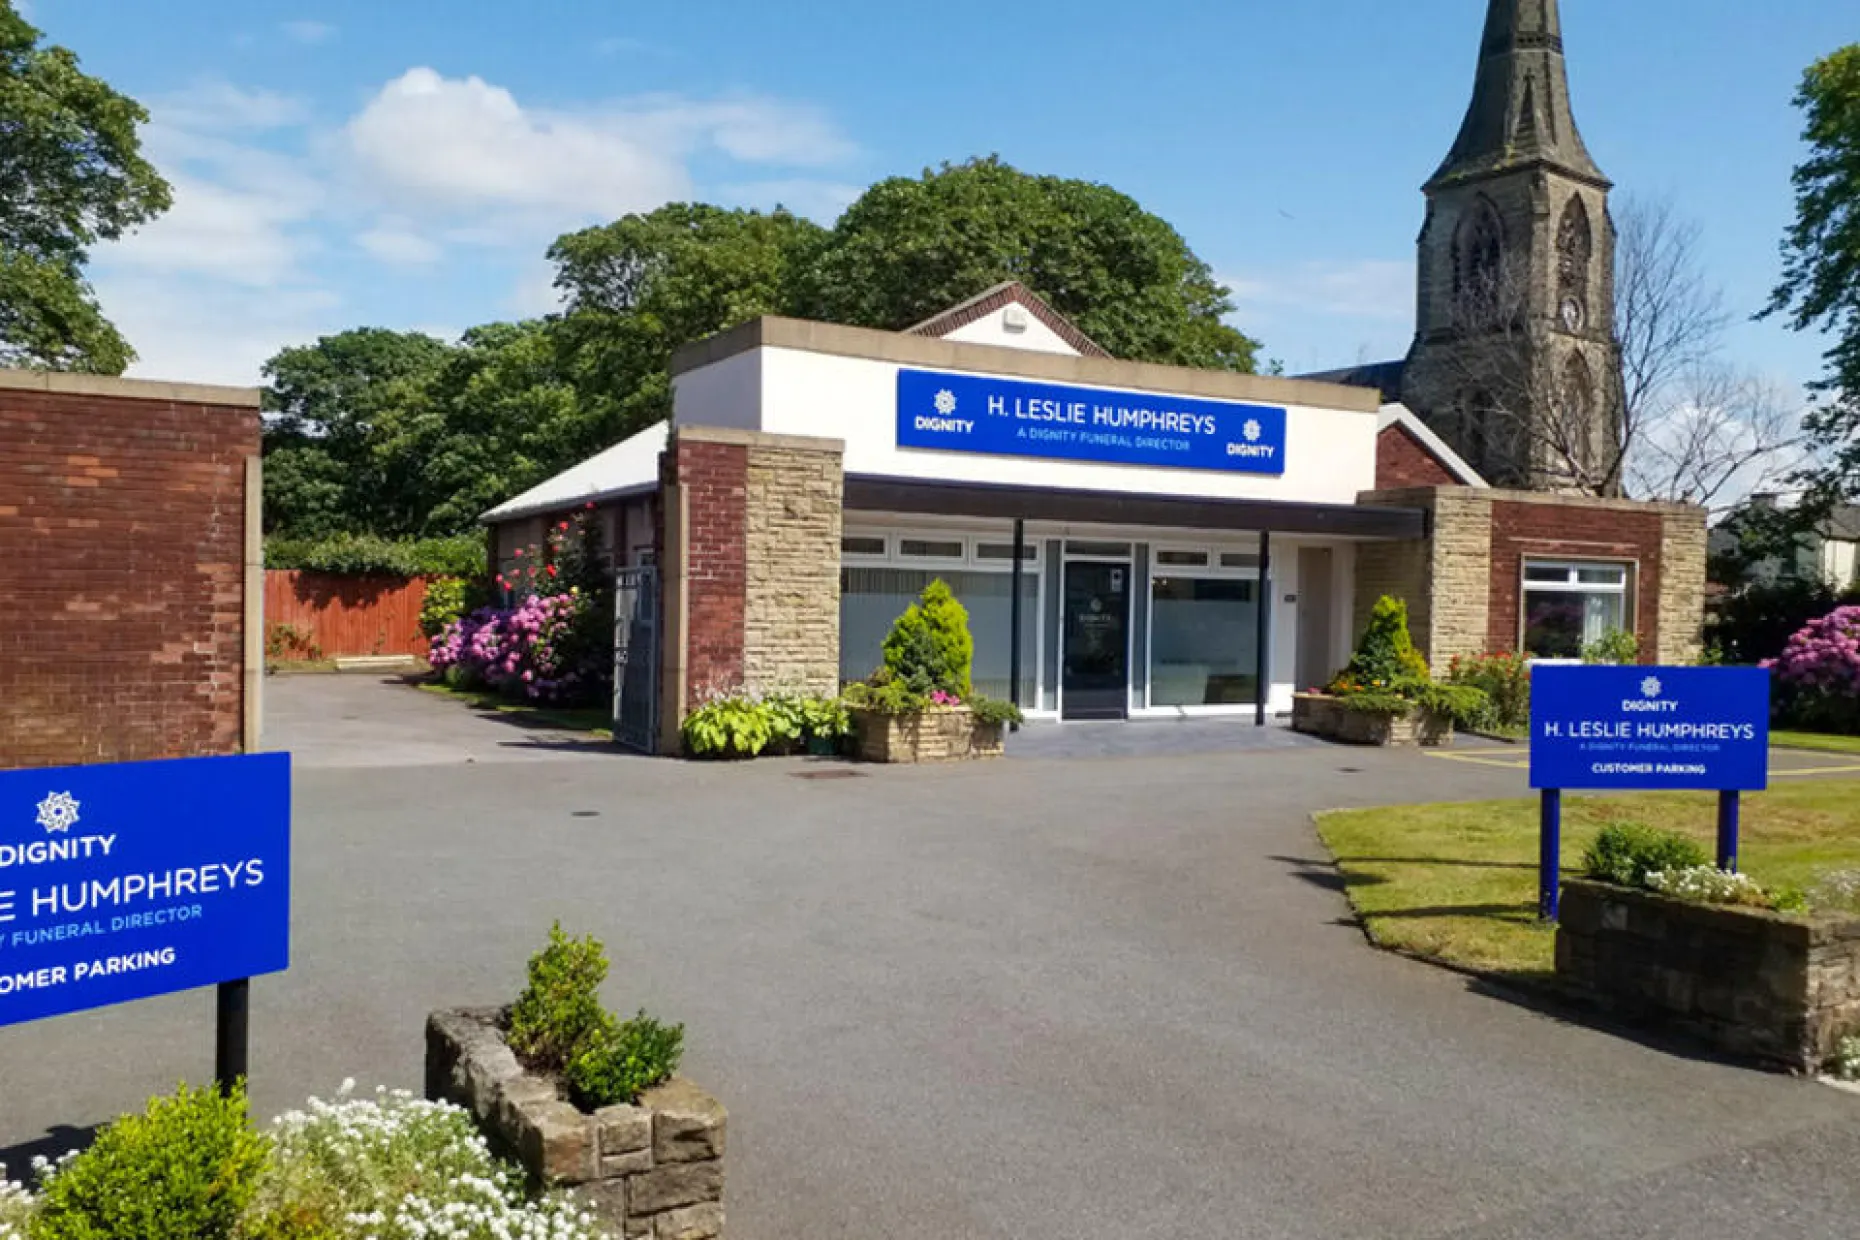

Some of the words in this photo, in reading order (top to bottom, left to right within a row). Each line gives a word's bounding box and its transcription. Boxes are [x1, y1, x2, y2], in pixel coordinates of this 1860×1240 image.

[914, 415, 974, 434] DIGNITY
[987, 394, 1009, 417] H.
[1014, 398, 1086, 424] LESLIE
[1092, 404, 1216, 435] HUMPHREYS
[1016, 427, 1026, 439] A
[1029, 427, 1076, 442] DIGNITY
[1079, 431, 1132, 448] FUNERAL
[1135, 435, 1190, 451] DIRECTOR
[1226, 442, 1275, 458] DIGNITY
[1621, 699, 1679, 712] DIGNITY
[1544, 721, 1563, 737] H.
[1568, 721, 1632, 738] LESLIE
[1637, 722, 1755, 740] HUMPHREYS
[1591, 762, 1653, 774] CUSTOMER
[1656, 763, 1706, 774] PARKING
[0, 833, 117, 868] DIGNITY
[32, 858, 264, 916] HUMPHREYS
[11, 919, 105, 947] FUNERAL
[111, 904, 202, 931] DIRECTOR
[74, 947, 176, 981] PARKING
